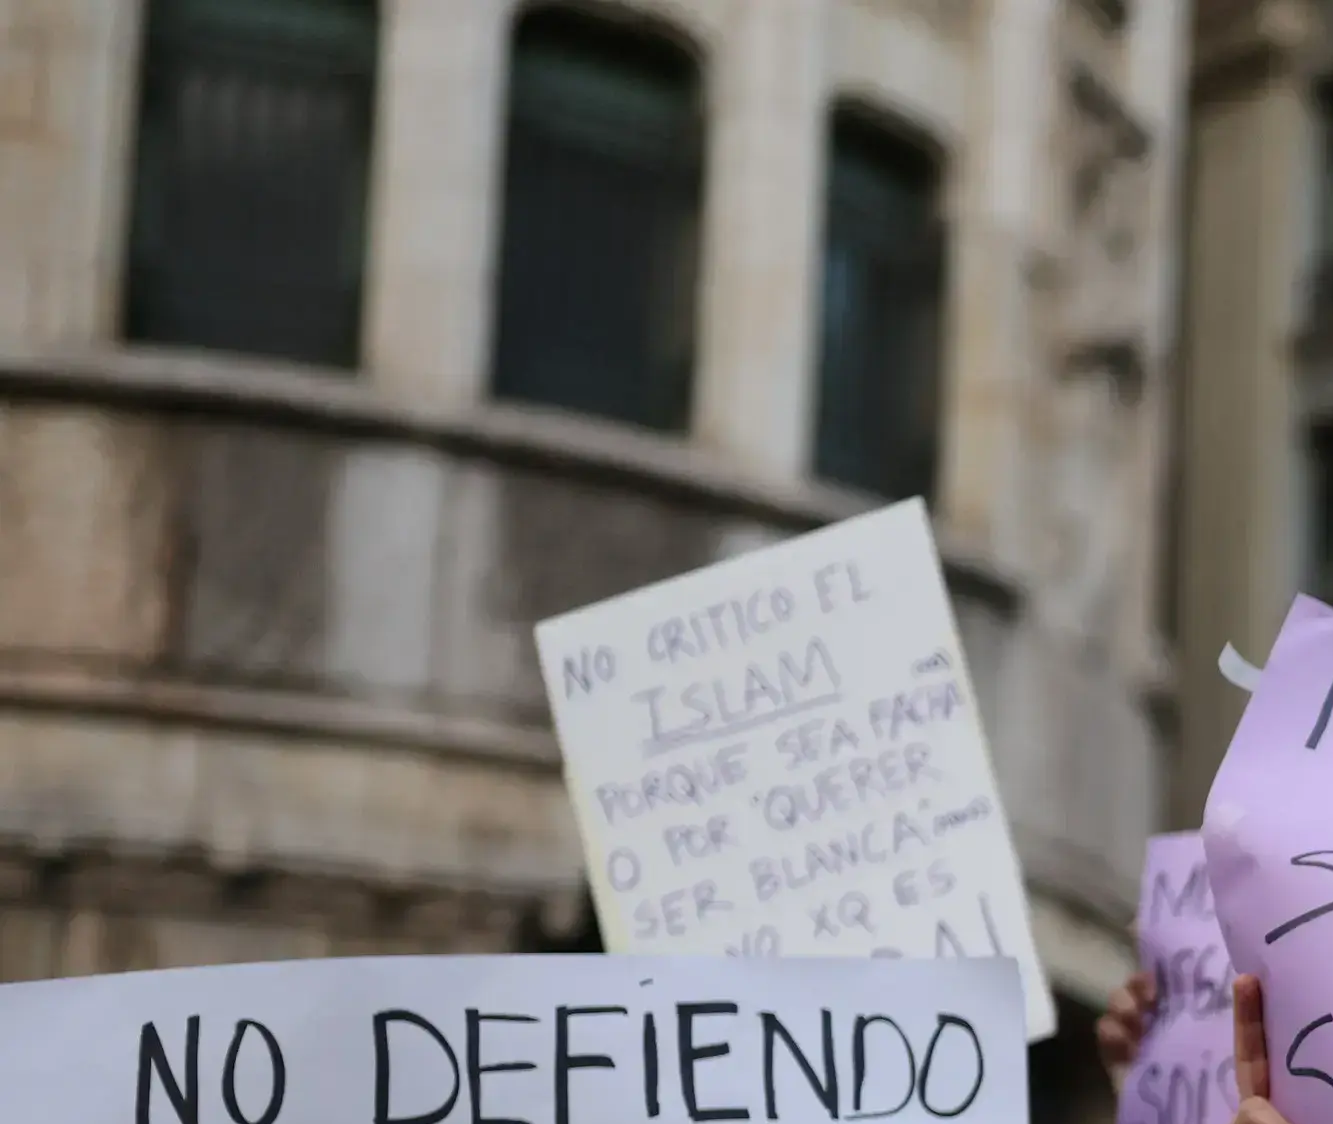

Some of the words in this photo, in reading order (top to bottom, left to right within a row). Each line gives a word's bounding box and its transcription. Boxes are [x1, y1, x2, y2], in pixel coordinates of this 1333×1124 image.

[560, 644, 617, 702] NO
[646, 585, 796, 664] CRITICO
[812, 558, 873, 615] EL
[628, 634, 843, 743] ISLAM
[596, 740, 750, 826] PORQUE
[775, 718, 862, 772] SEA
[607, 845, 642, 893] O
[662, 812, 740, 867] POR
[892, 857, 958, 908] ES
[634, 878, 735, 940] SER
